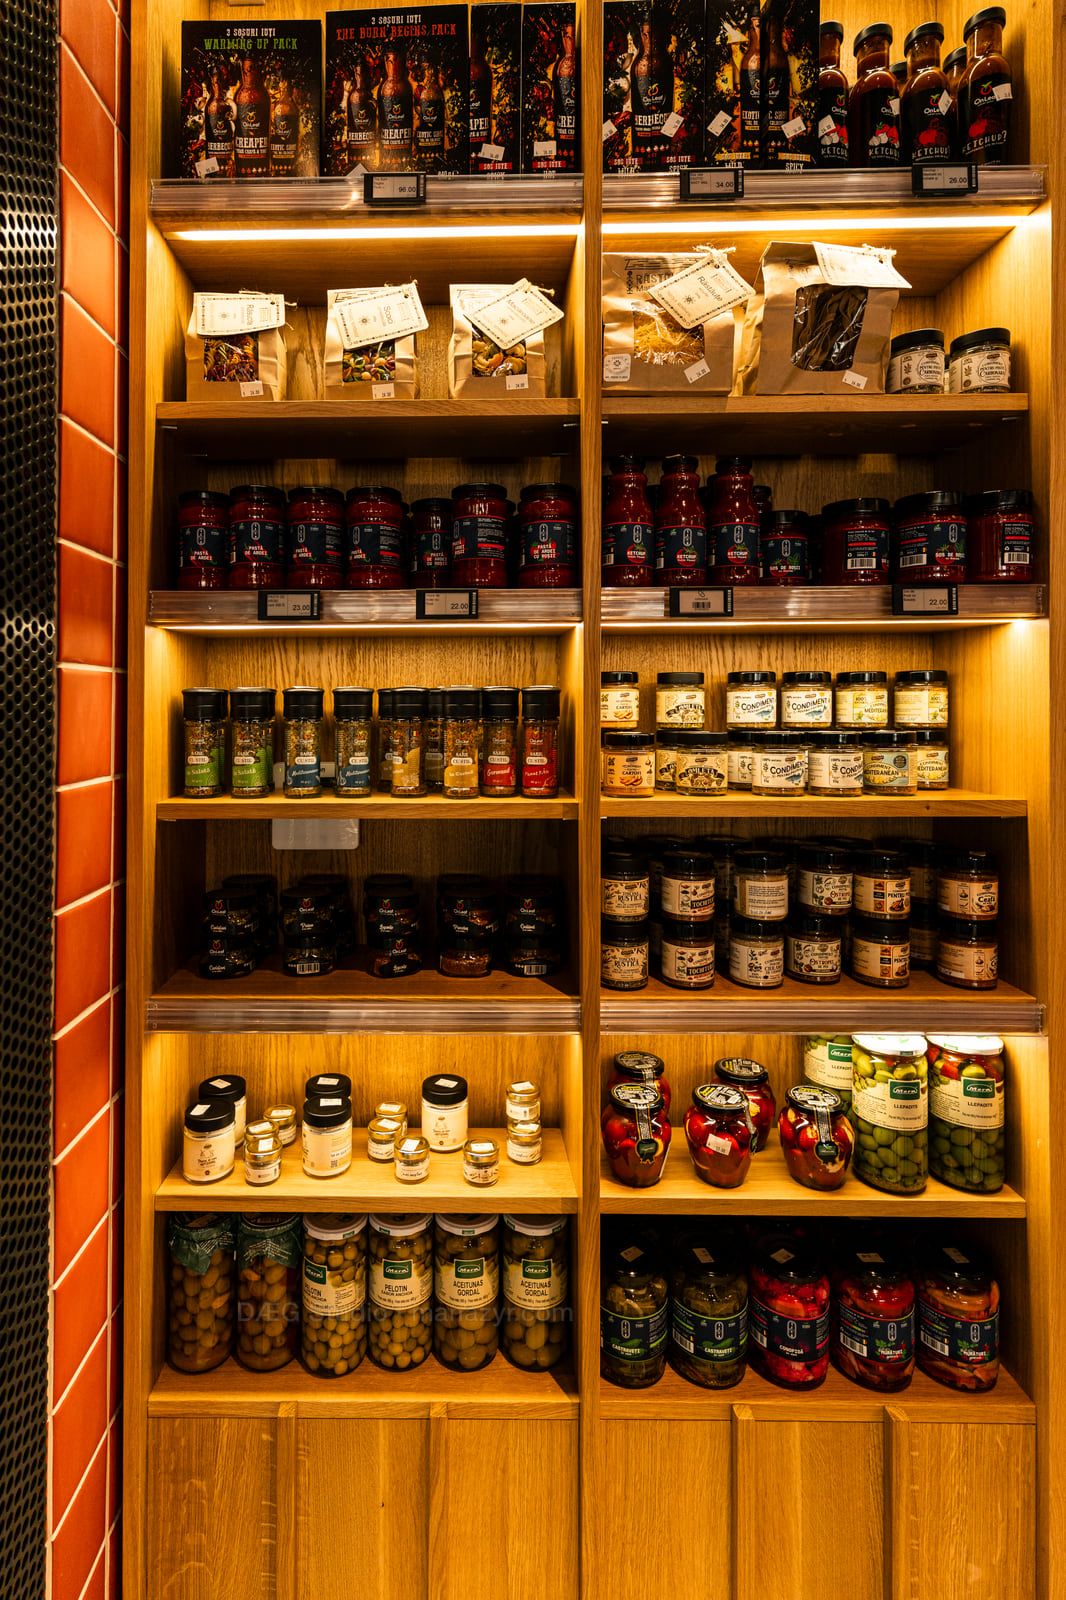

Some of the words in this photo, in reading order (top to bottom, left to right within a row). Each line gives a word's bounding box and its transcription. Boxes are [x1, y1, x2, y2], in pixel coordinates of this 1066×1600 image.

[371, 17, 376, 25] 3
[226, 28, 231, 37] 3
[336, 28, 355, 41] THE
[359, 26, 386, 39] BURN
[391, 25, 427, 38] BEGINS
[431, 23, 456, 35] PACK
[203, 38, 252, 50] WARMING
[256, 38, 269, 50] UP
[273, 38, 298, 50] PACK
[741, 697, 774, 711] CONDIMENT
[791, 698, 828, 711] CONDIMENT
[453, 1279, 483, 1288] ACEITUNAS
[520, 1280, 552, 1289] ACEITUNAS
[385, 1284, 408, 1293] PELOTIN
[457, 1288, 480, 1296] GORDAL
[525, 1288, 548, 1296] GORDAL
